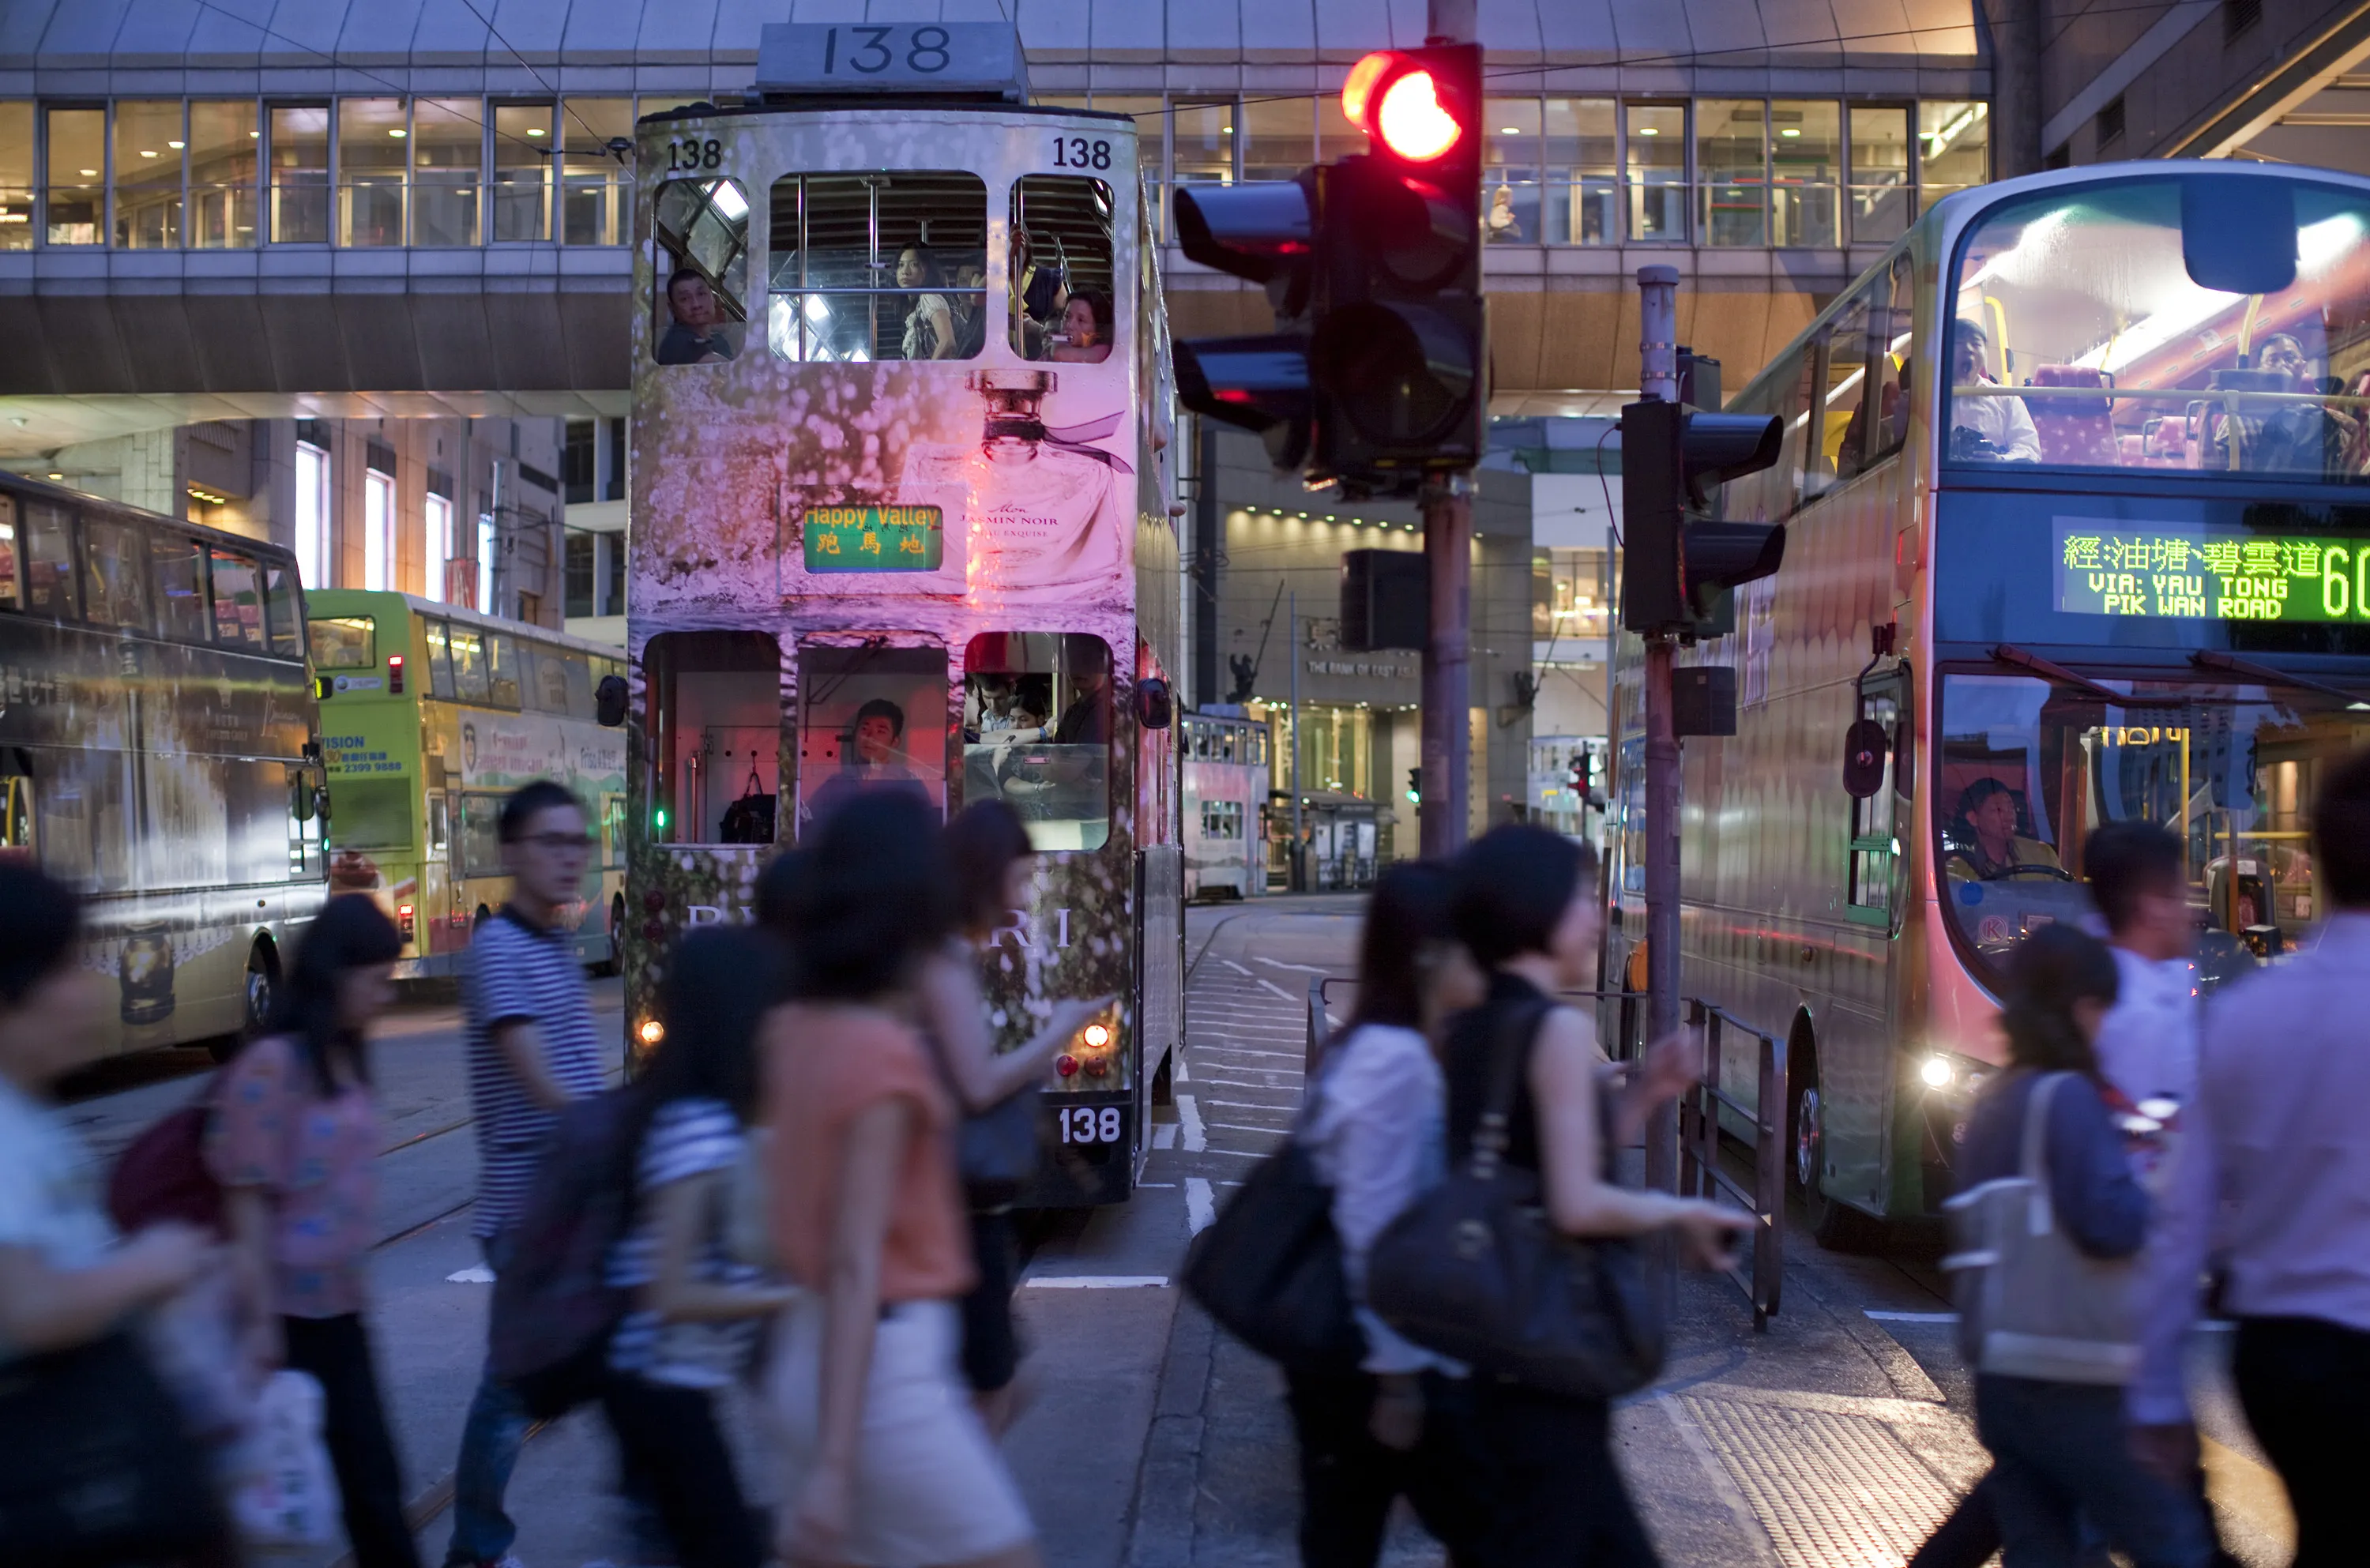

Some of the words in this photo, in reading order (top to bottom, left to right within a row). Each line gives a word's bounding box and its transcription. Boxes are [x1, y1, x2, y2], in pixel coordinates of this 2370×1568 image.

[824, 26, 950, 74] 138
[668, 139, 721, 171] 138
[1053, 137, 1111, 171] 138
[804, 507, 867, 529] Happy
[878, 506, 939, 530] Valley
[960, 514, 1016, 525] JASMIN
[1021, 517, 1059, 525] NOIR
[817, 531, 925, 555] 跑馬地
[1004, 529, 1048, 538] EXQUISE
[2089, 572, 2143, 594] VIA:
[2152, 573, 2203, 596] YAU
[2220, 576, 2289, 600] TONG
[2104, 593, 2146, 615] PIK
[2157, 596, 2206, 618] WAN
[2218, 596, 2282, 620] ROAD
[1307, 660, 1327, 673] THE
[1329, 661, 1356, 675] BANK
[1059, 1107, 1121, 1144] 138
